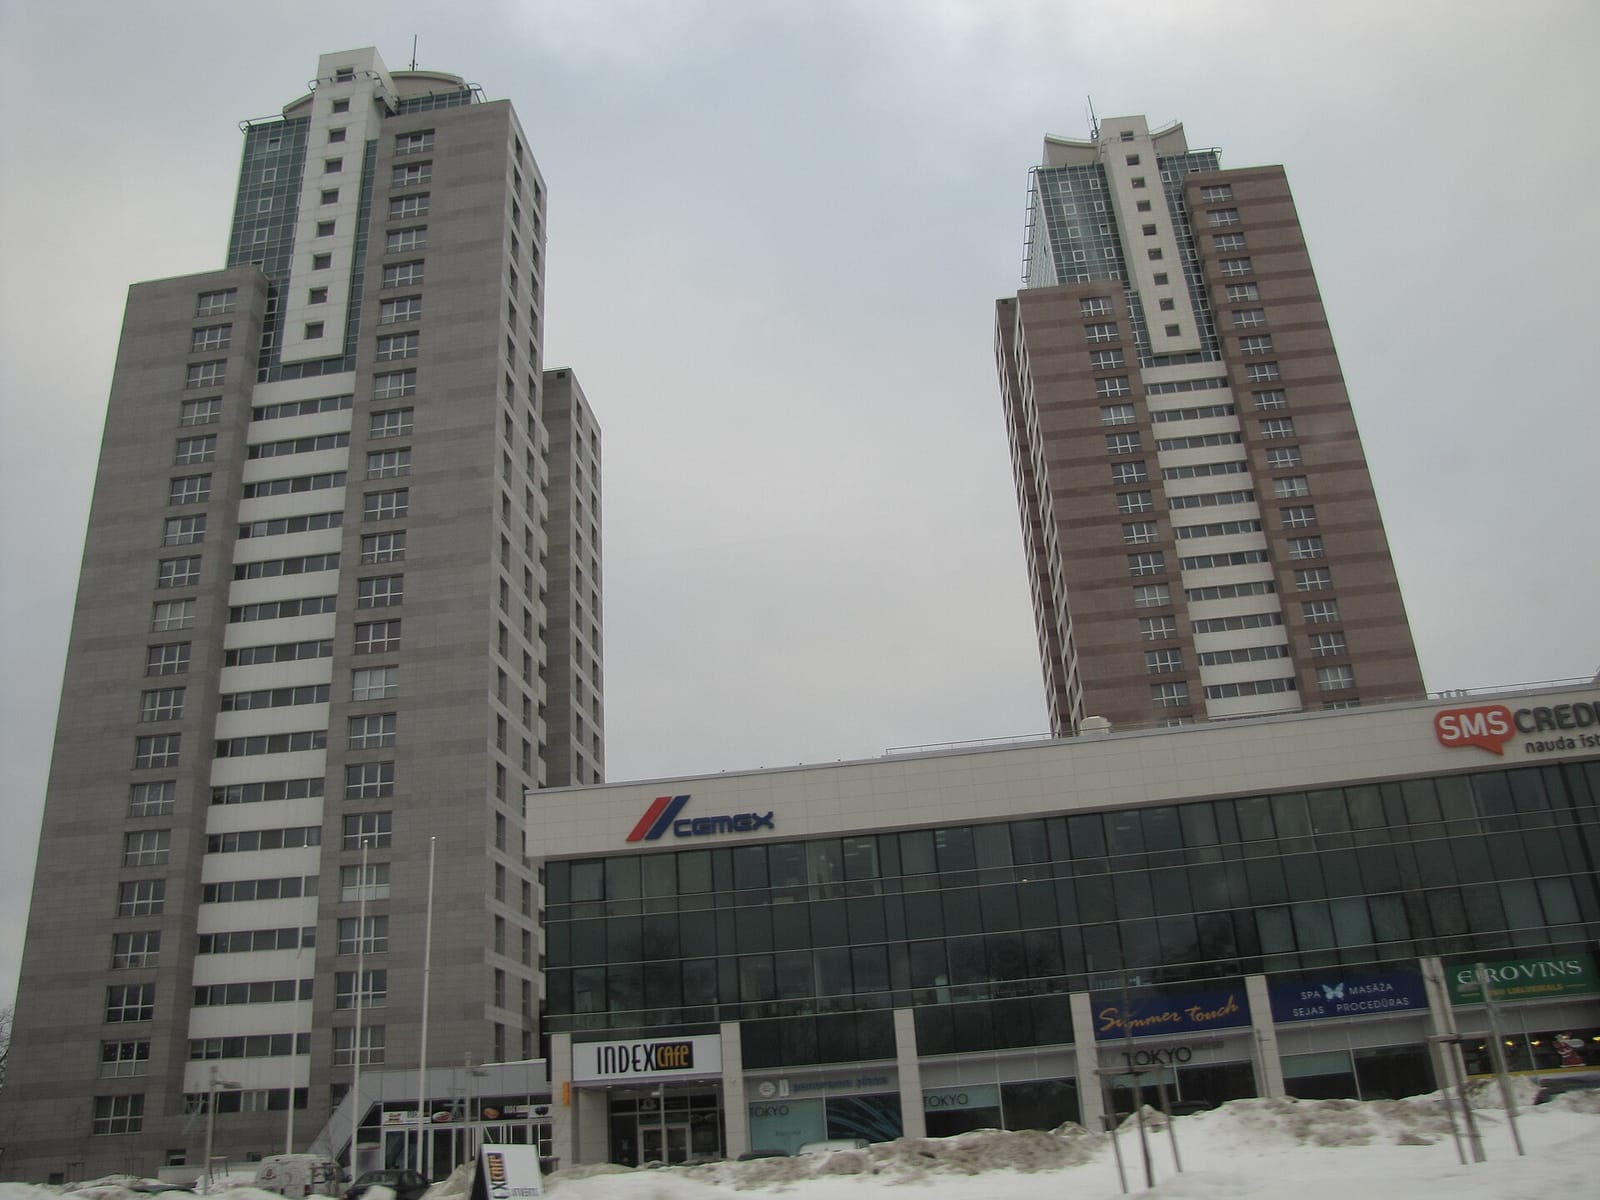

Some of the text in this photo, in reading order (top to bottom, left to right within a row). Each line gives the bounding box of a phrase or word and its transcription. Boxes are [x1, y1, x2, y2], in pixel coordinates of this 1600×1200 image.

[1439, 711, 1509, 740] SMS
[1526, 735, 1576, 753] nauda
[1300, 990, 1321, 1000] SPA
[1292, 1006, 1325, 1017] SEJAS
[597, 1043, 656, 1074] INDEX
[1122, 1046, 1192, 1072] TOKYO
